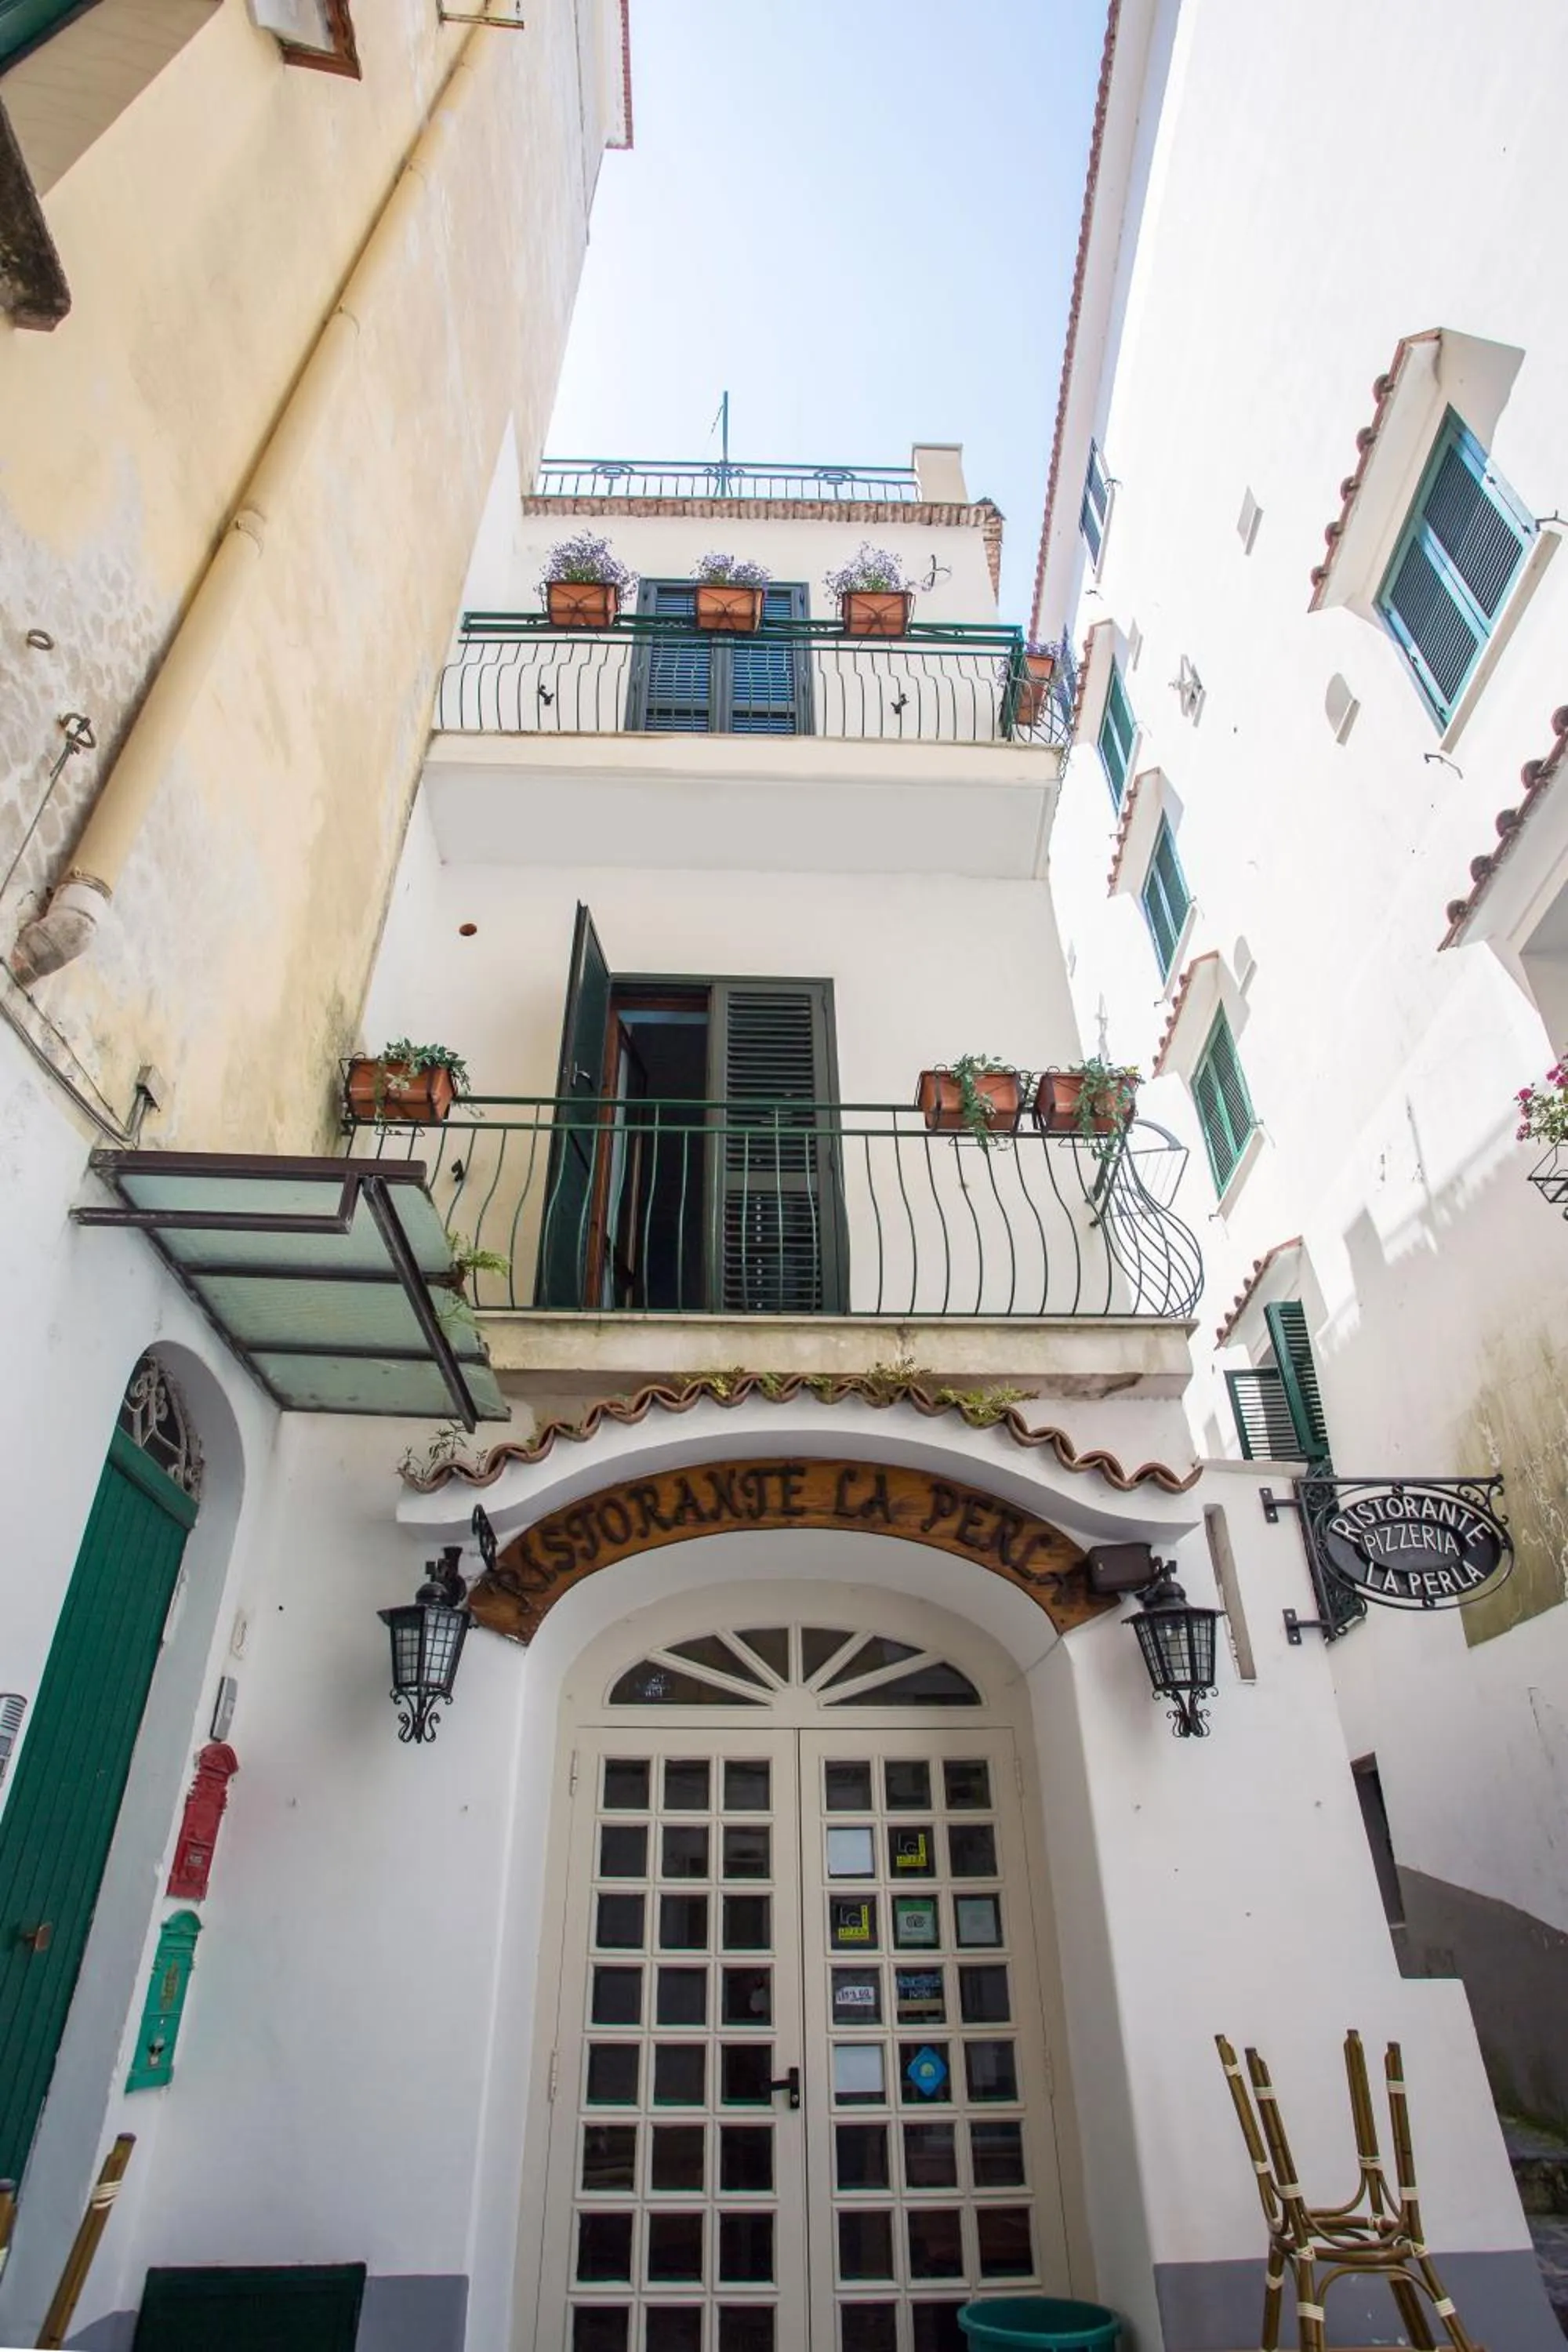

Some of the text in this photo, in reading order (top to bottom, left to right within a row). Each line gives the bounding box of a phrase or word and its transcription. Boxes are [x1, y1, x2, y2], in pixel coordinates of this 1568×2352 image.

[491, 1465, 808, 1613] RISTORANTE
[833, 1467, 892, 1523] LA
[1331, 1496, 1493, 1547] RISTORANTE
[1363, 1523, 1461, 1558] PIZZERIA
[1367, 1559, 1486, 1596] LA PERLA
